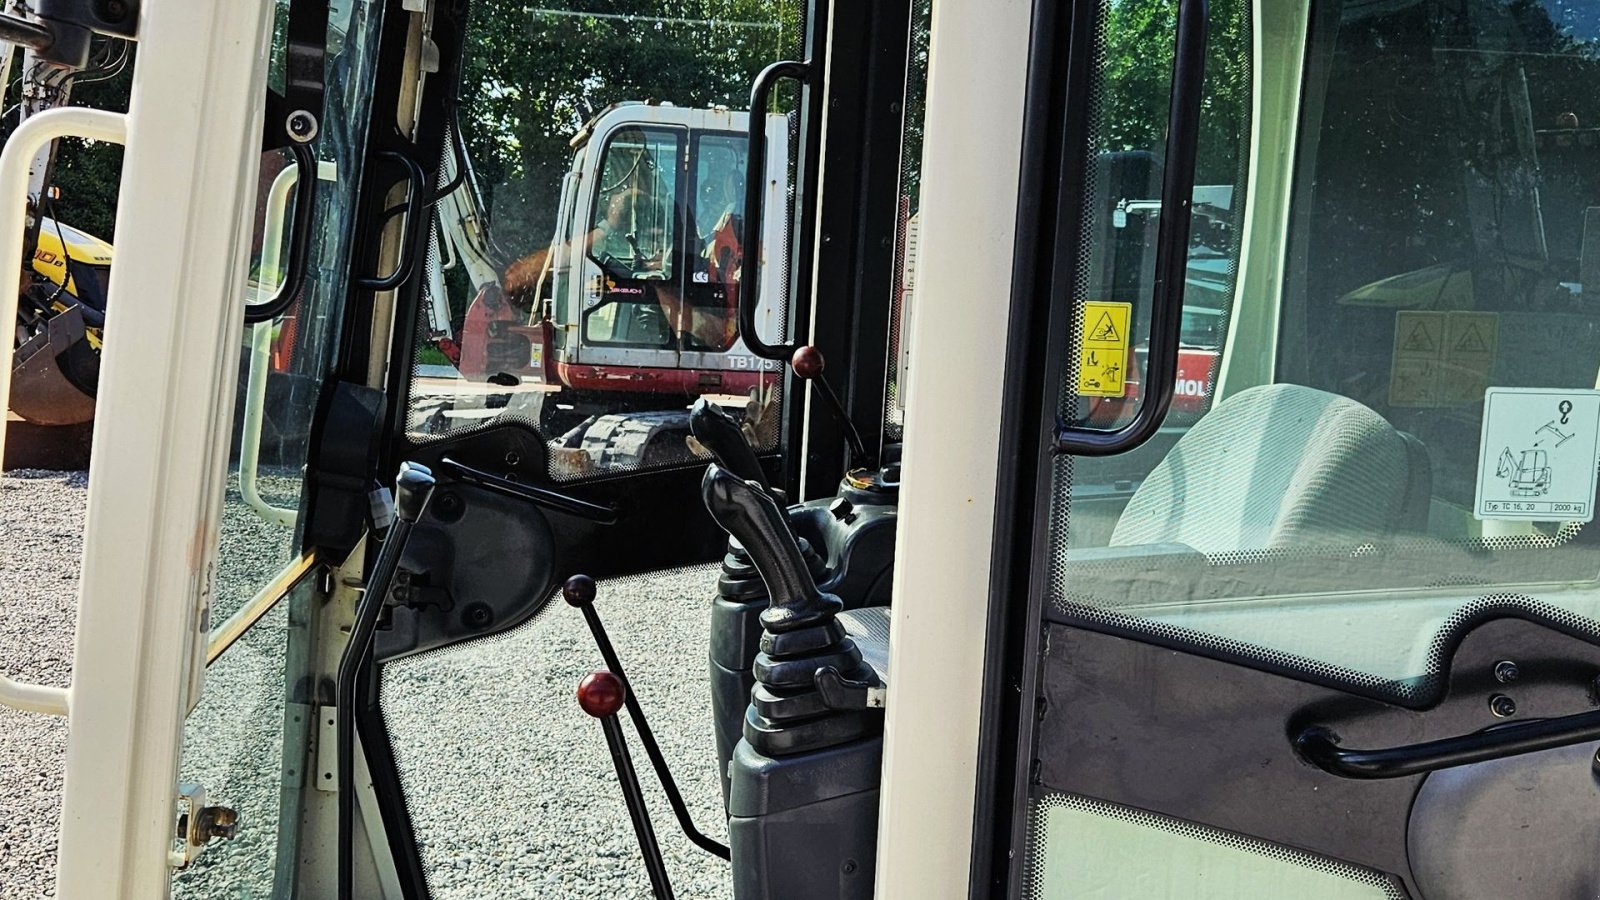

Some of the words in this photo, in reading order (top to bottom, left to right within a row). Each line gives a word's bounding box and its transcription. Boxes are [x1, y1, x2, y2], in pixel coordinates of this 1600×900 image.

[727, 355, 774, 370] TB175
[1488, 502, 1499, 511] Typ
[1526, 503, 1536, 511] 20
[1573, 505, 1582, 514] kg
